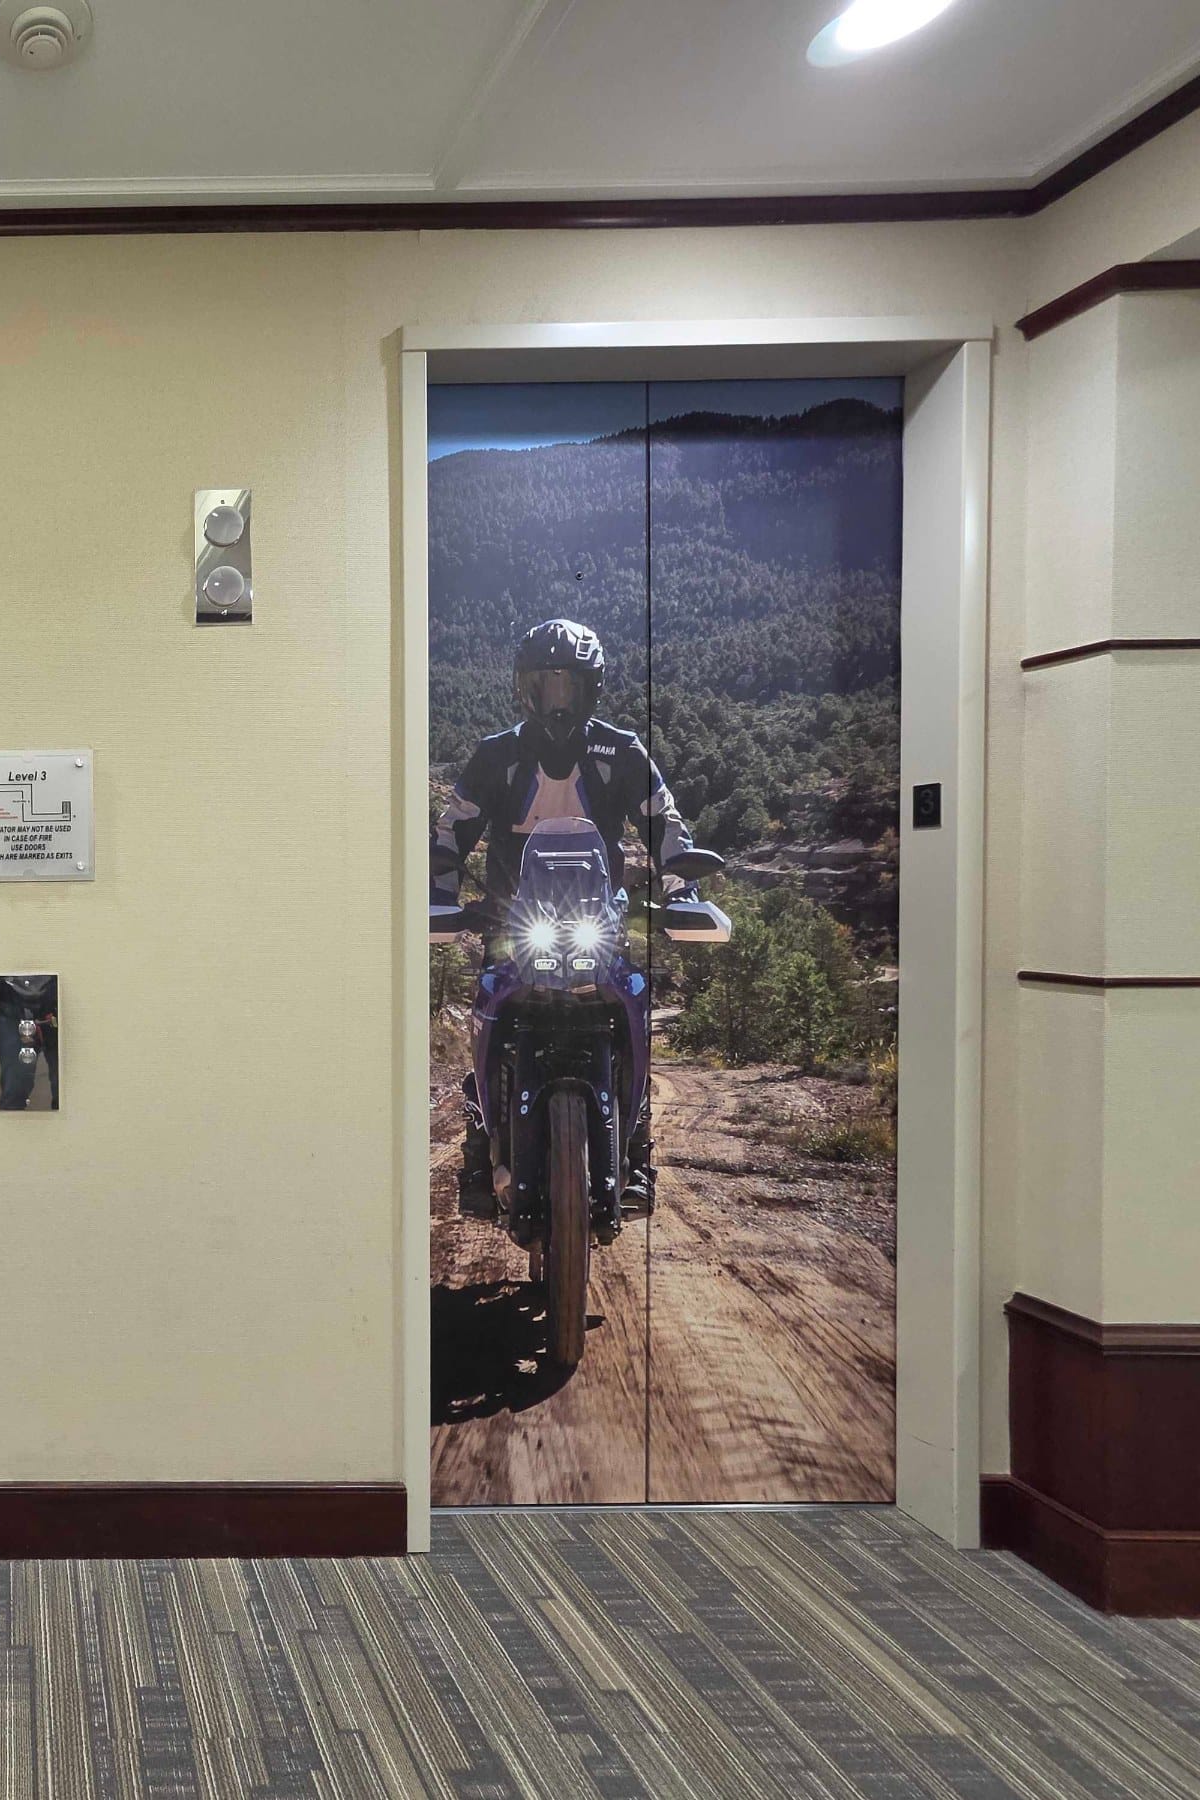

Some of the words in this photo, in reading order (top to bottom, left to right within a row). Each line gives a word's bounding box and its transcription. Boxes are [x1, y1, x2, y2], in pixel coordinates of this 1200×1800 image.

[8, 771, 38, 782] Level
[40, 770, 47, 781] 3
[920, 789, 934, 815] 3
[17, 825, 31, 833] MAY
[31, 825, 44, 833] NOT
[45, 825, 54, 833] BE
[54, 824, 72, 832] USED
[11, 834, 28, 842] CASE
[29, 834, 38, 842] OF
[38, 834, 53, 842] FIRE
[24, 843, 46, 851] DOORS
[5, 853, 18, 861] ARE
[19, 852, 45, 860] MARKED
[45, 852, 55, 860] AS
[55, 852, 73, 860] EXITS
